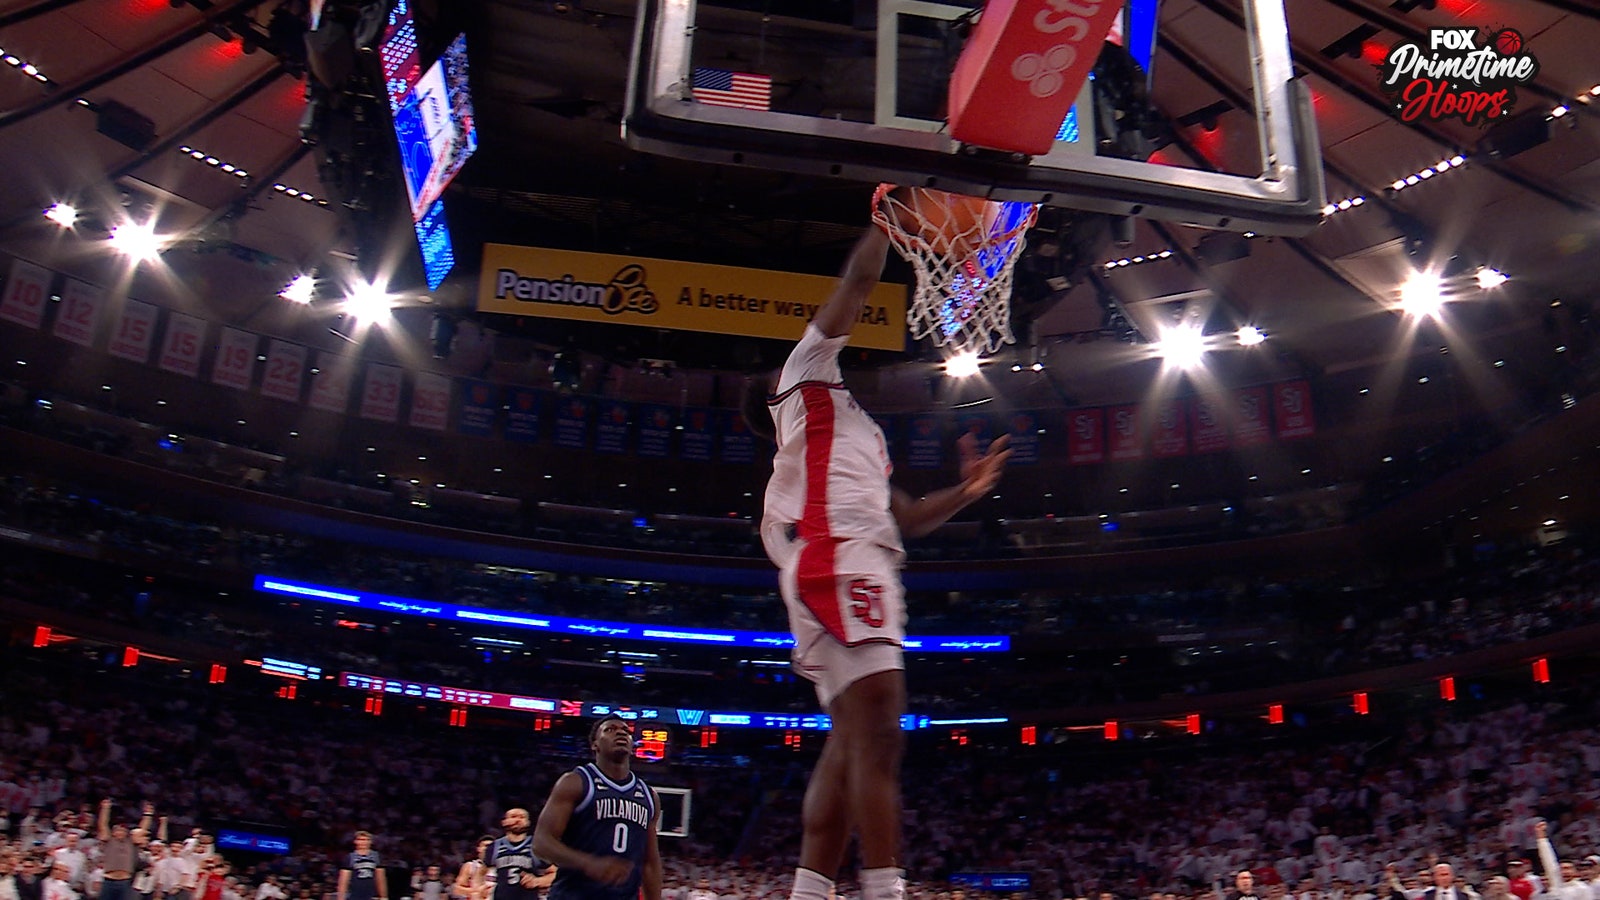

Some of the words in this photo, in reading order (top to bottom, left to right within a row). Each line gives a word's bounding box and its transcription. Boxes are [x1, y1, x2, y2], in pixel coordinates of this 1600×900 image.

[10, 279, 42, 306] 10
[495, 264, 659, 315] PensionBee
[63, 298, 93, 325] 12
[677, 286, 693, 306] A
[699, 287, 770, 314] better
[774, 298, 819, 322] way
[119, 315, 148, 342] 15
[170, 331, 198, 356] 15
[222, 345, 250, 370] 19
[269, 357, 301, 383] 22
[368, 380, 398, 403] 33
[596, 797, 649, 830] VILLANOVA
[612, 822, 629, 853] 0
[507, 867, 521, 885] 5
